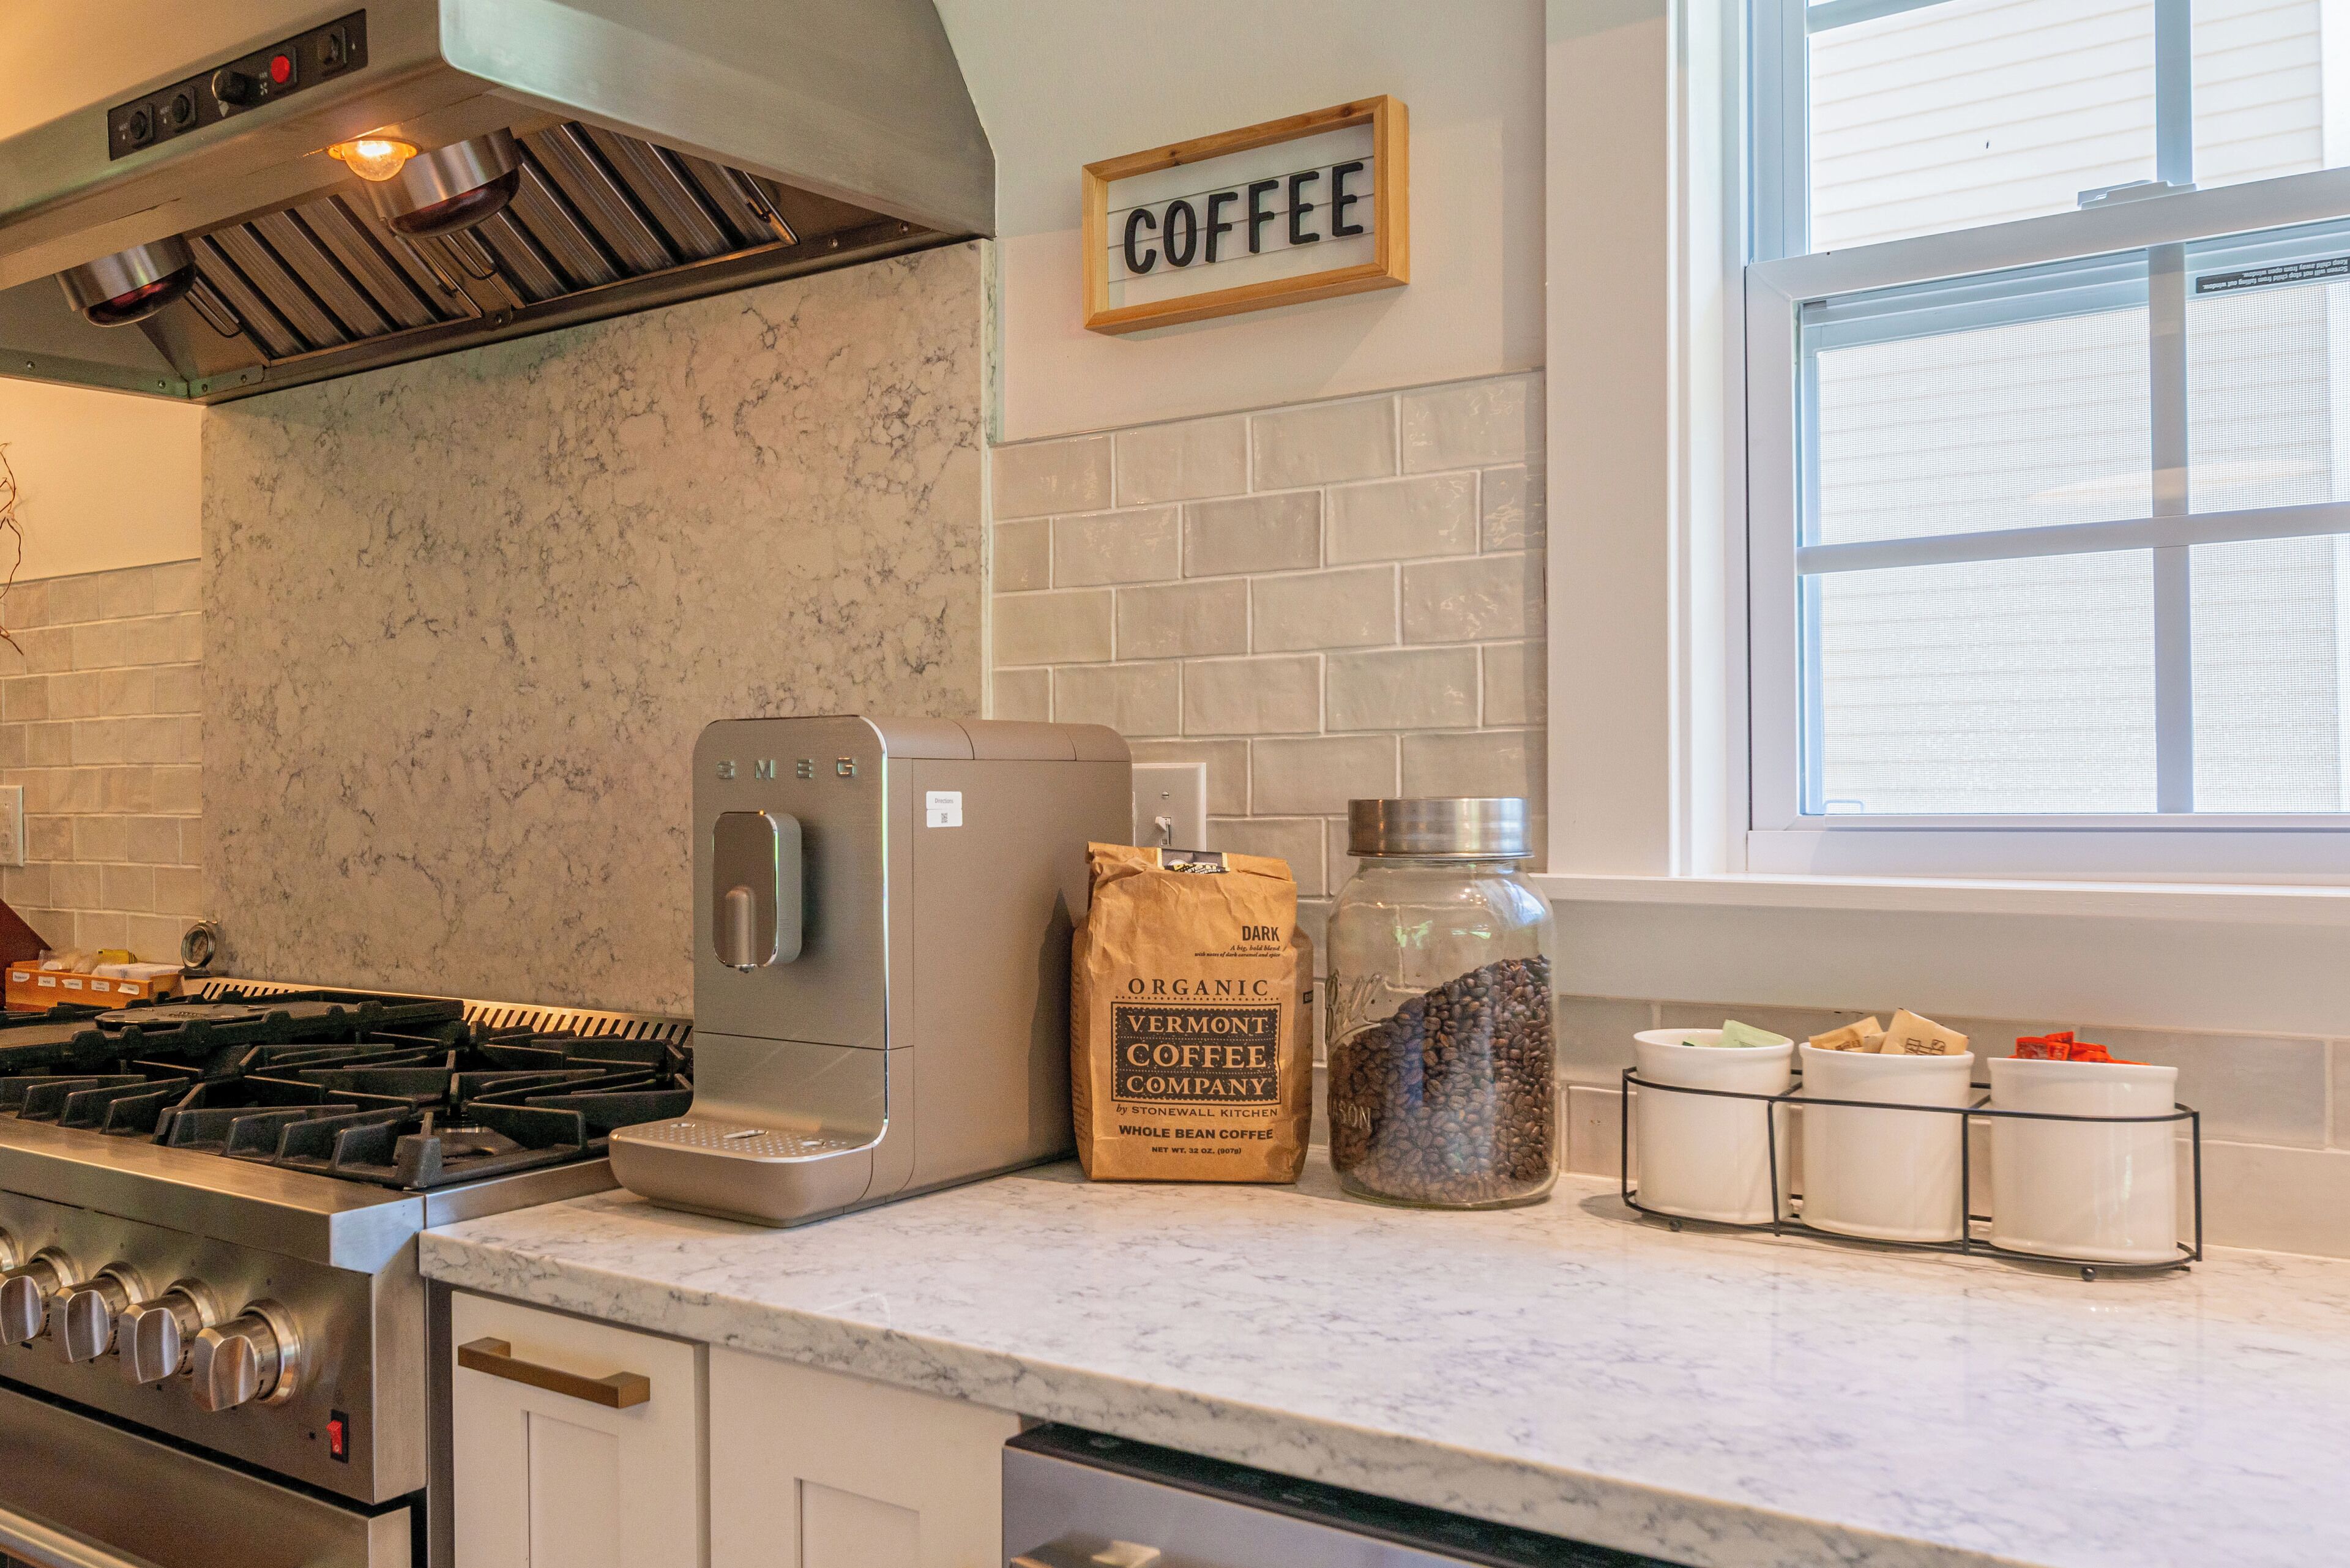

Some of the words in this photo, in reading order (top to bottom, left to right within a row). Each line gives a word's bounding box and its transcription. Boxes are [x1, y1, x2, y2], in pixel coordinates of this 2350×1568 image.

[1124, 162, 1364, 275] COFFEE
[2242, 269, 2267, 278] window.
[716, 757, 857, 780] SMEG
[1242, 925, 1280, 942] DARK
[1128, 978, 1268, 996] ORGANIC
[1127, 1015, 1269, 1034] VERMONT
[1127, 1043, 1267, 1069] COFFEE
[1126, 1076, 1268, 1096] COMPANY
[1116, 1103, 1128, 1115] by
[1132, 1106, 1215, 1117] STONEWALL
[1220, 1108, 1278, 1118] KITCHEN
[1119, 1125, 1171, 1138] WHOLE
[1175, 1129, 1215, 1139] BEAN
[1219, 1129, 1274, 1140] COFFEE
